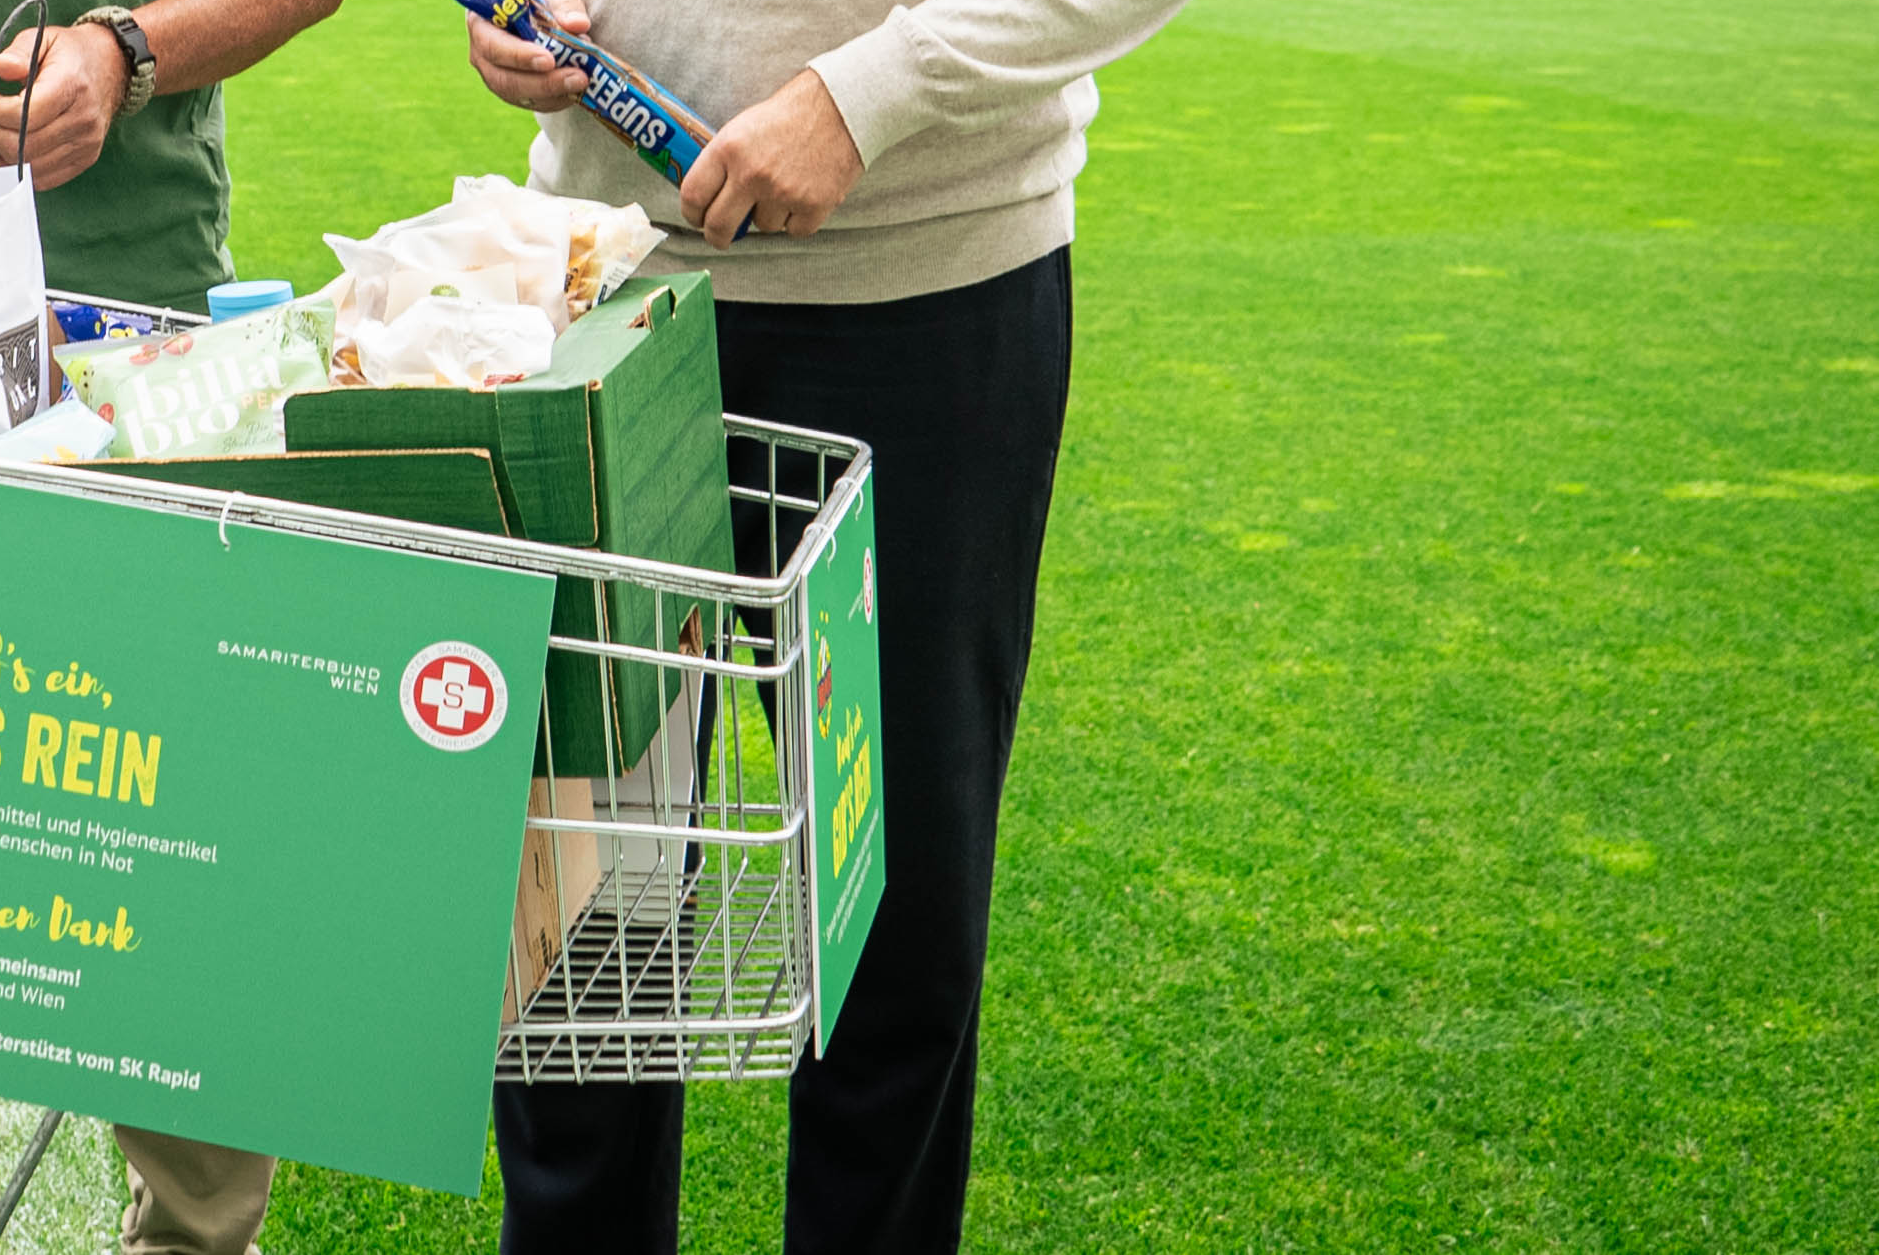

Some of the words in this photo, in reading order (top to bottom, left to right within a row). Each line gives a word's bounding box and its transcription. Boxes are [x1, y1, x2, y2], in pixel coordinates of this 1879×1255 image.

[582, 64, 667, 149] SUPER
[133, 355, 287, 419] billa
[124, 401, 240, 459] bio
[217, 641, 381, 681] SAMARITERBUND
[45, 662, 112, 710] ein,
[330, 675, 379, 696] WIEN
[443, 682, 464, 709] S
[21, 712, 162, 807] REIN
[47, 815, 80, 837] und
[87, 820, 217, 863] Hygieneartikel
[79, 847, 95, 866] in
[102, 852, 134, 873] Not
[49, 895, 142, 952] Dank
[20, 984, 66, 1010] Wien
[77, 1051, 114, 1072] vom
[119, 1056, 144, 1079] SK
[148, 1063, 201, 1091] Rapid
